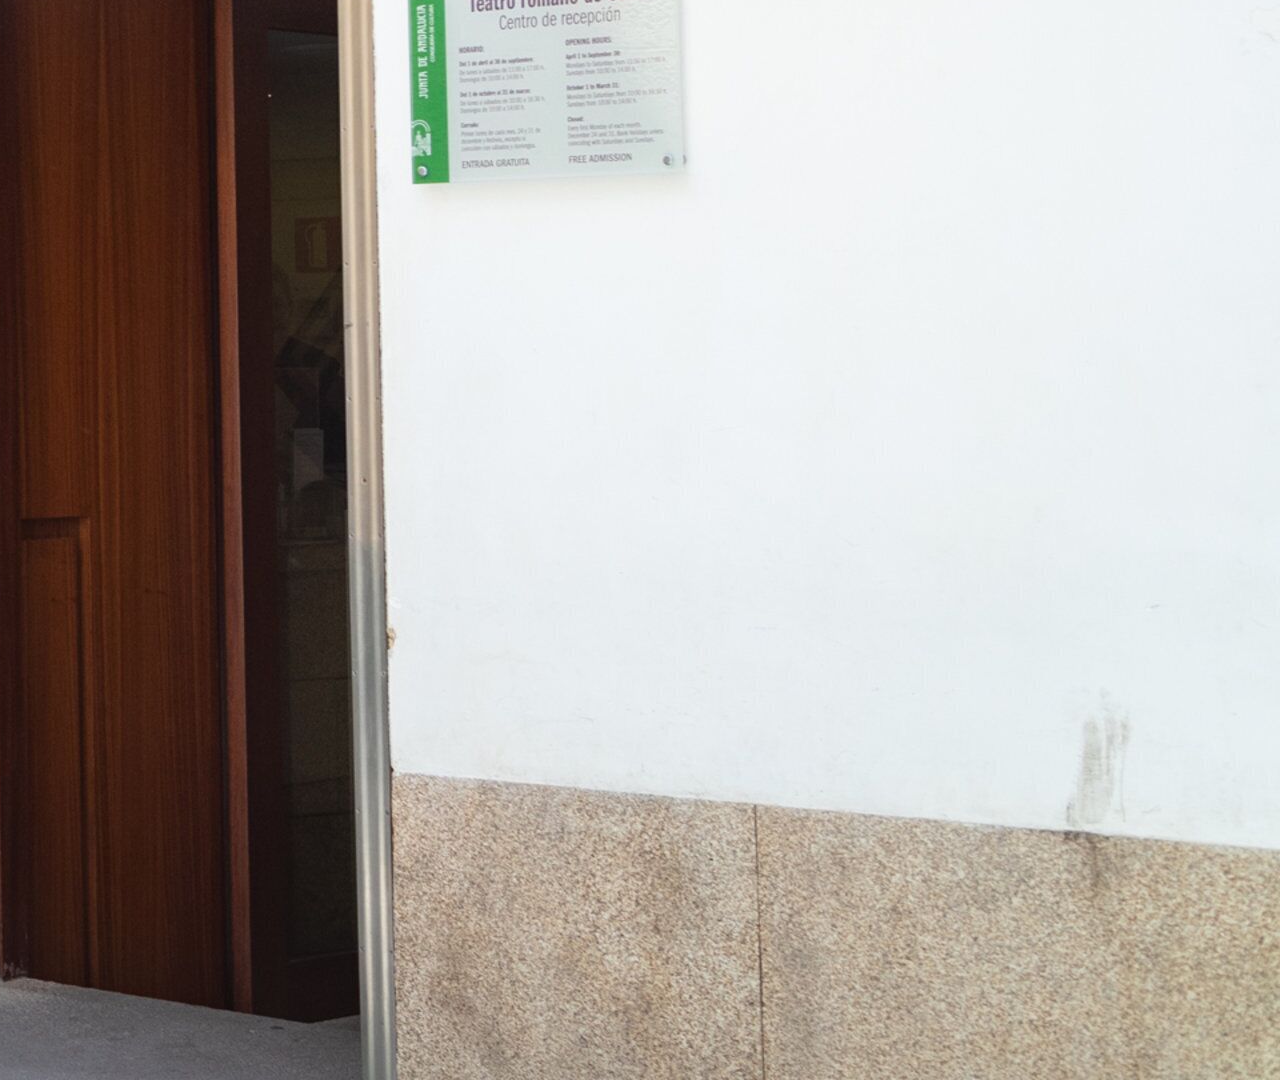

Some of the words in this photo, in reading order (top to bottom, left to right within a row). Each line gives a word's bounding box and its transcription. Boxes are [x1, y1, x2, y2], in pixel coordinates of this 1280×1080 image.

[499, 13, 538, 31] Centro
[542, 11, 557, 27] de
[561, 6, 621, 27] recepción
[418, 56, 428, 68] DE
[418, 71, 429, 99] JUNTA
[462, 159, 494, 169] ENTRADA
[495, 157, 530, 167] GRATUITA
[568, 155, 587, 164] FREE
[588, 152, 633, 163] ADMISSION
